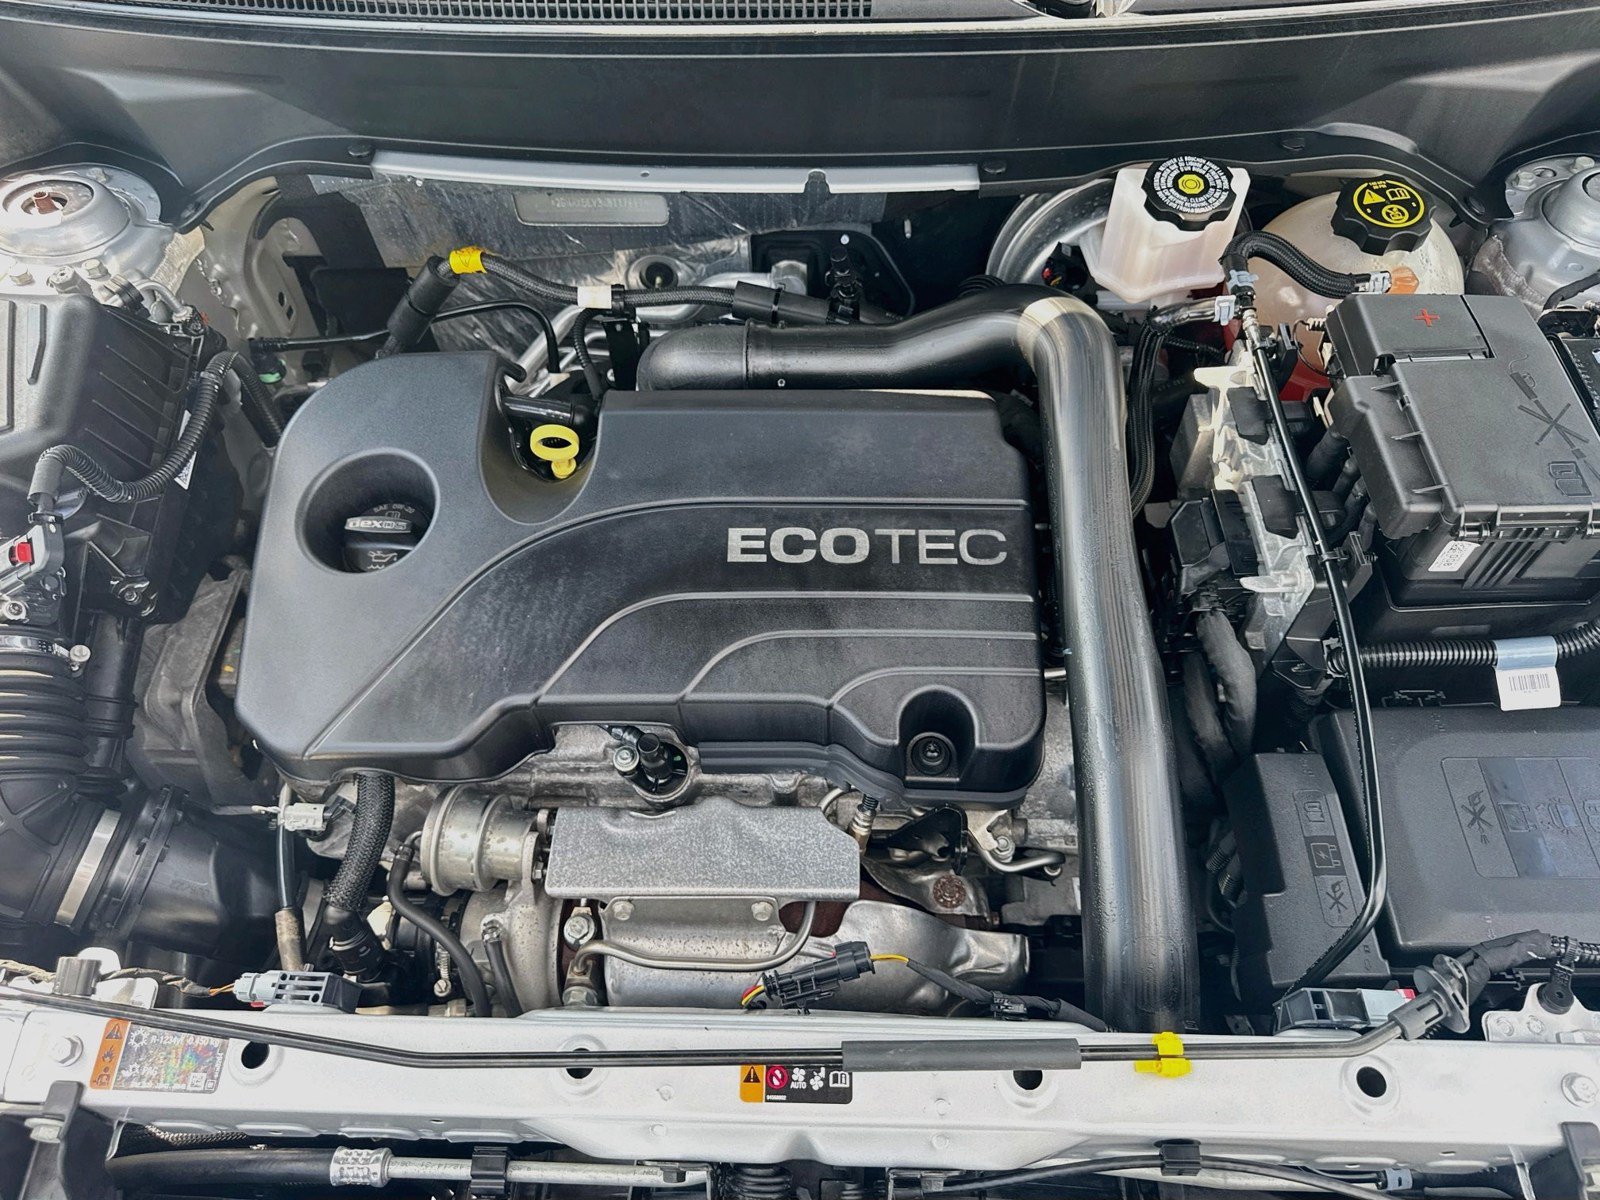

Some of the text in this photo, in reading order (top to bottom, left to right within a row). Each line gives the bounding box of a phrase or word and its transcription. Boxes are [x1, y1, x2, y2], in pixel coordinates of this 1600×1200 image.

[348, 519, 408, 530] dexos
[727, 527, 1008, 565] ECOTEC
[790, 1081, 807, 1089] AUTO
